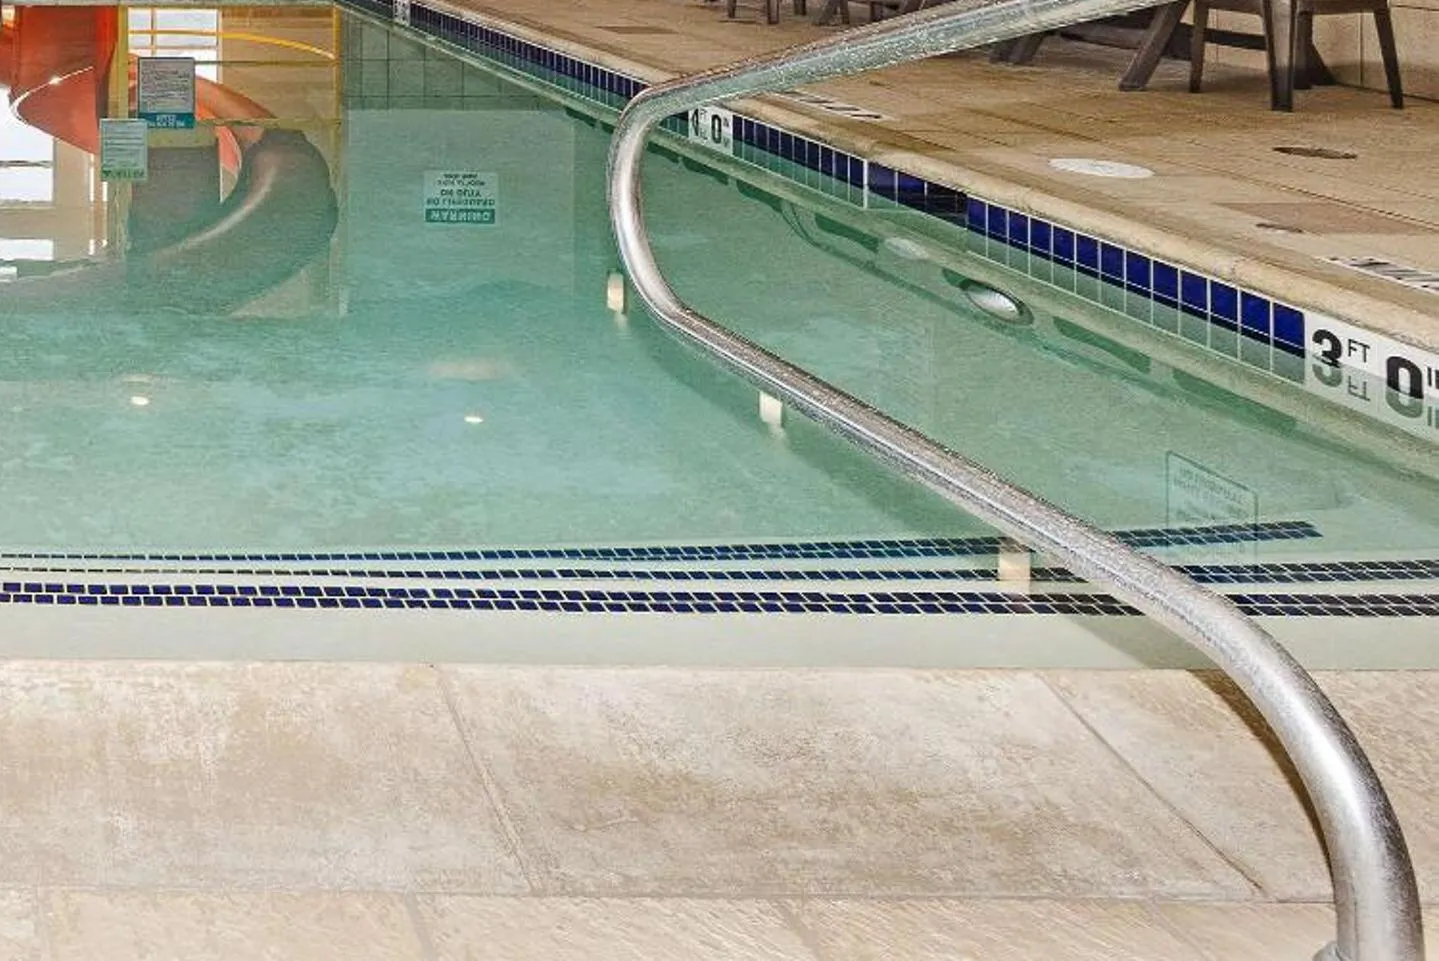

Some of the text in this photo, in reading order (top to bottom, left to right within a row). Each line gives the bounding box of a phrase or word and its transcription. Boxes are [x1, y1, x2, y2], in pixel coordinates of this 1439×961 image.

[1312, 329, 1342, 370] 3
[1347, 339, 1371, 363] FT
[1386, 356, 1424, 402] 0
